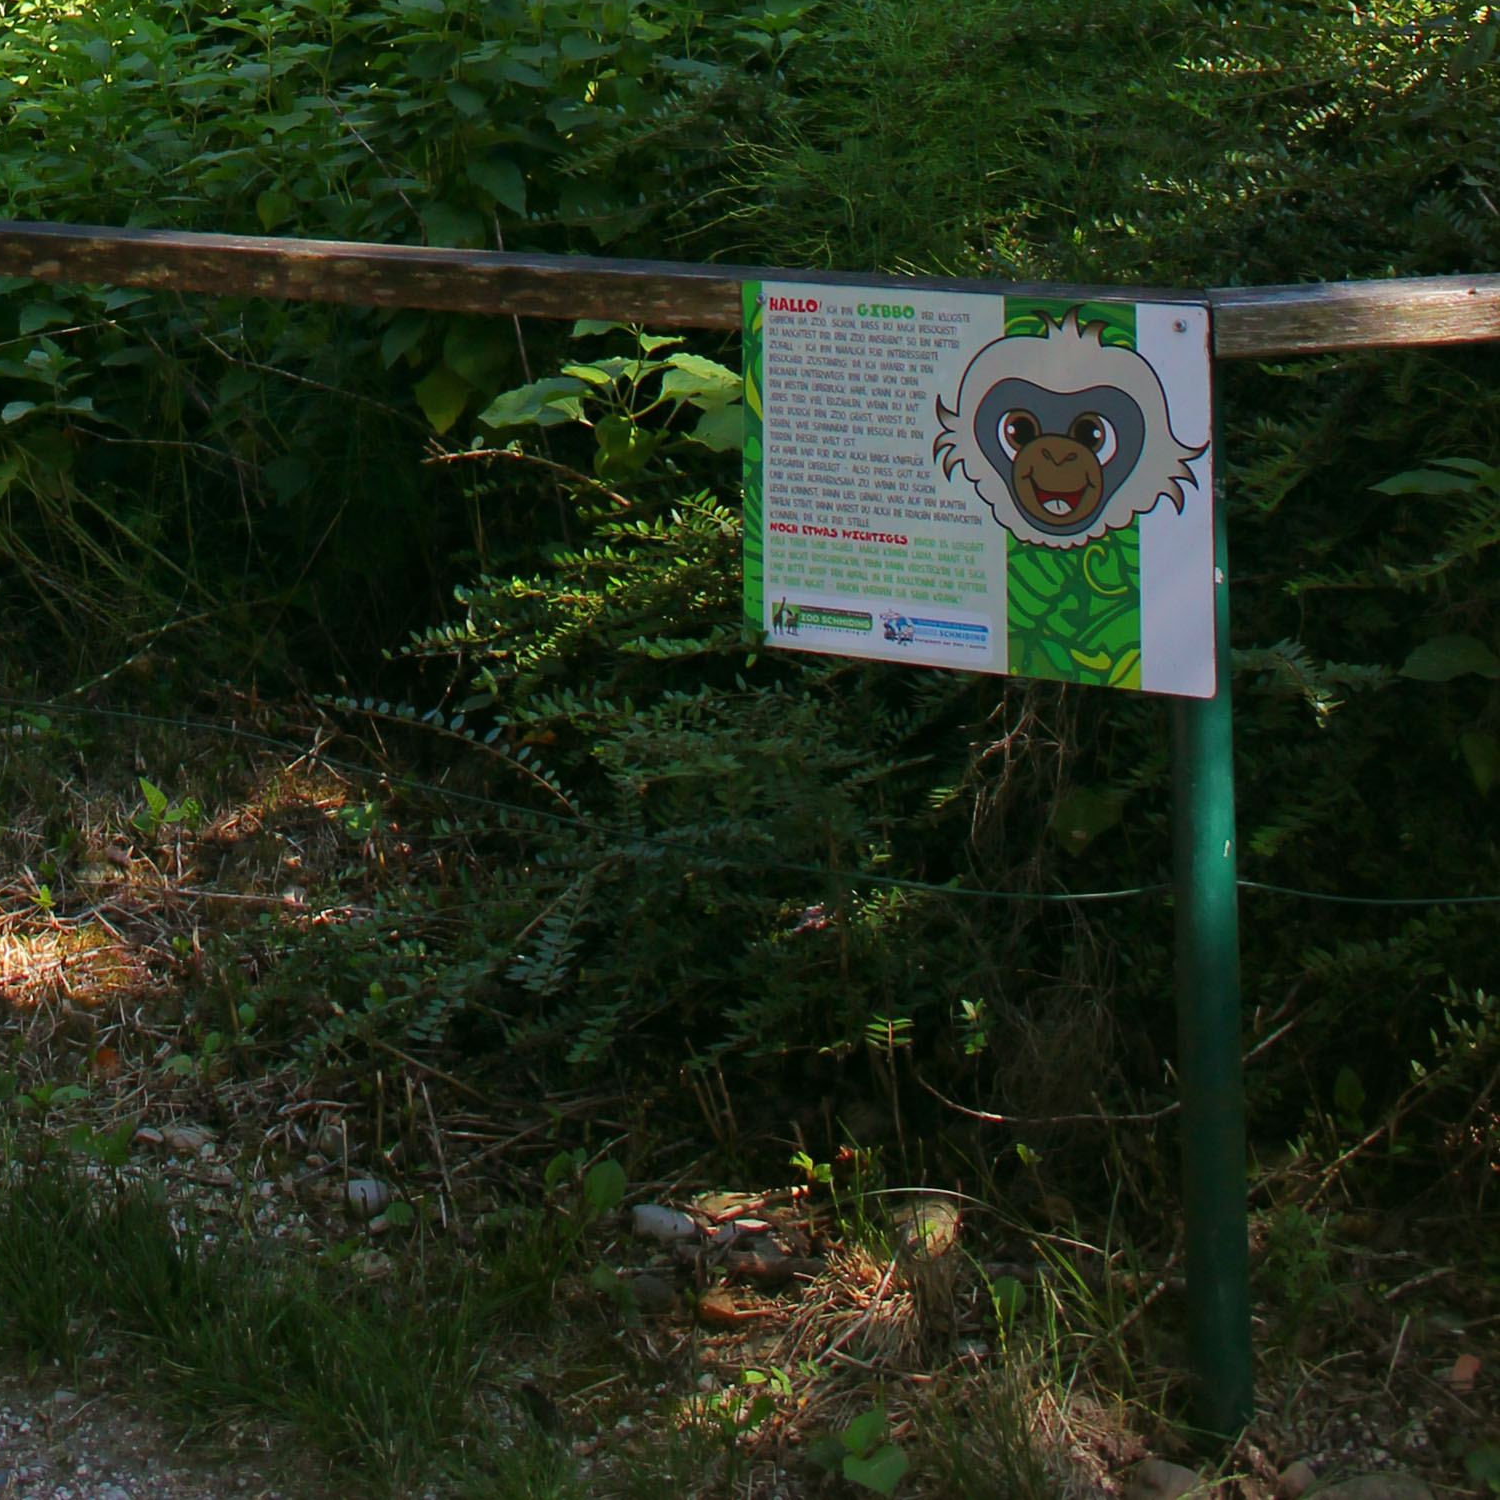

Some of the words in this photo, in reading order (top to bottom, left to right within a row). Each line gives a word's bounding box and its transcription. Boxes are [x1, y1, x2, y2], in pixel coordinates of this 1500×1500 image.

[769, 297, 822, 314] HALLO!
[770, 523, 798, 535] NOCH
[802, 525, 838, 538] ETWAS
[800, 613, 820, 623] ZOO
